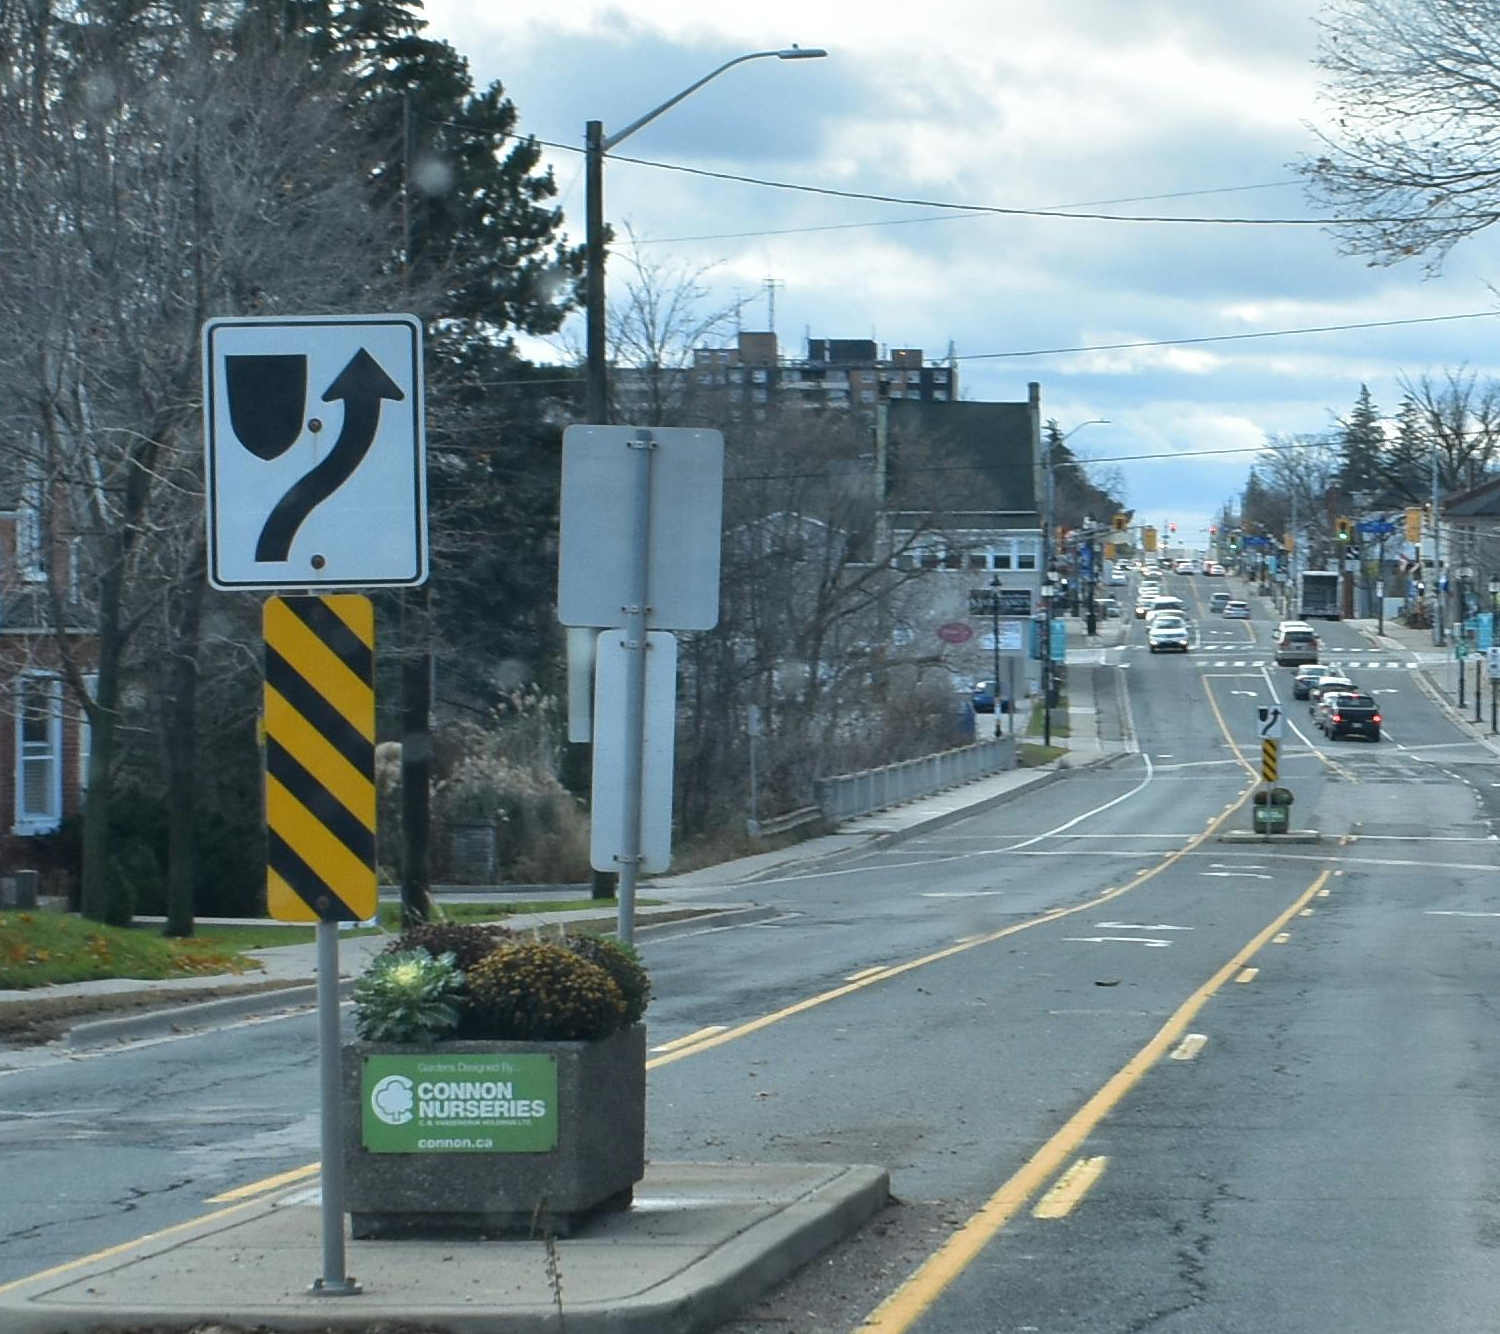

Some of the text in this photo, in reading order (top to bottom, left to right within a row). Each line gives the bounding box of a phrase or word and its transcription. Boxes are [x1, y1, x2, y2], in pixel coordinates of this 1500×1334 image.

[418, 1082, 513, 1100] CONNON
[419, 1100, 546, 1119] NURSERIES
[418, 1138, 493, 1148] connon.ca
